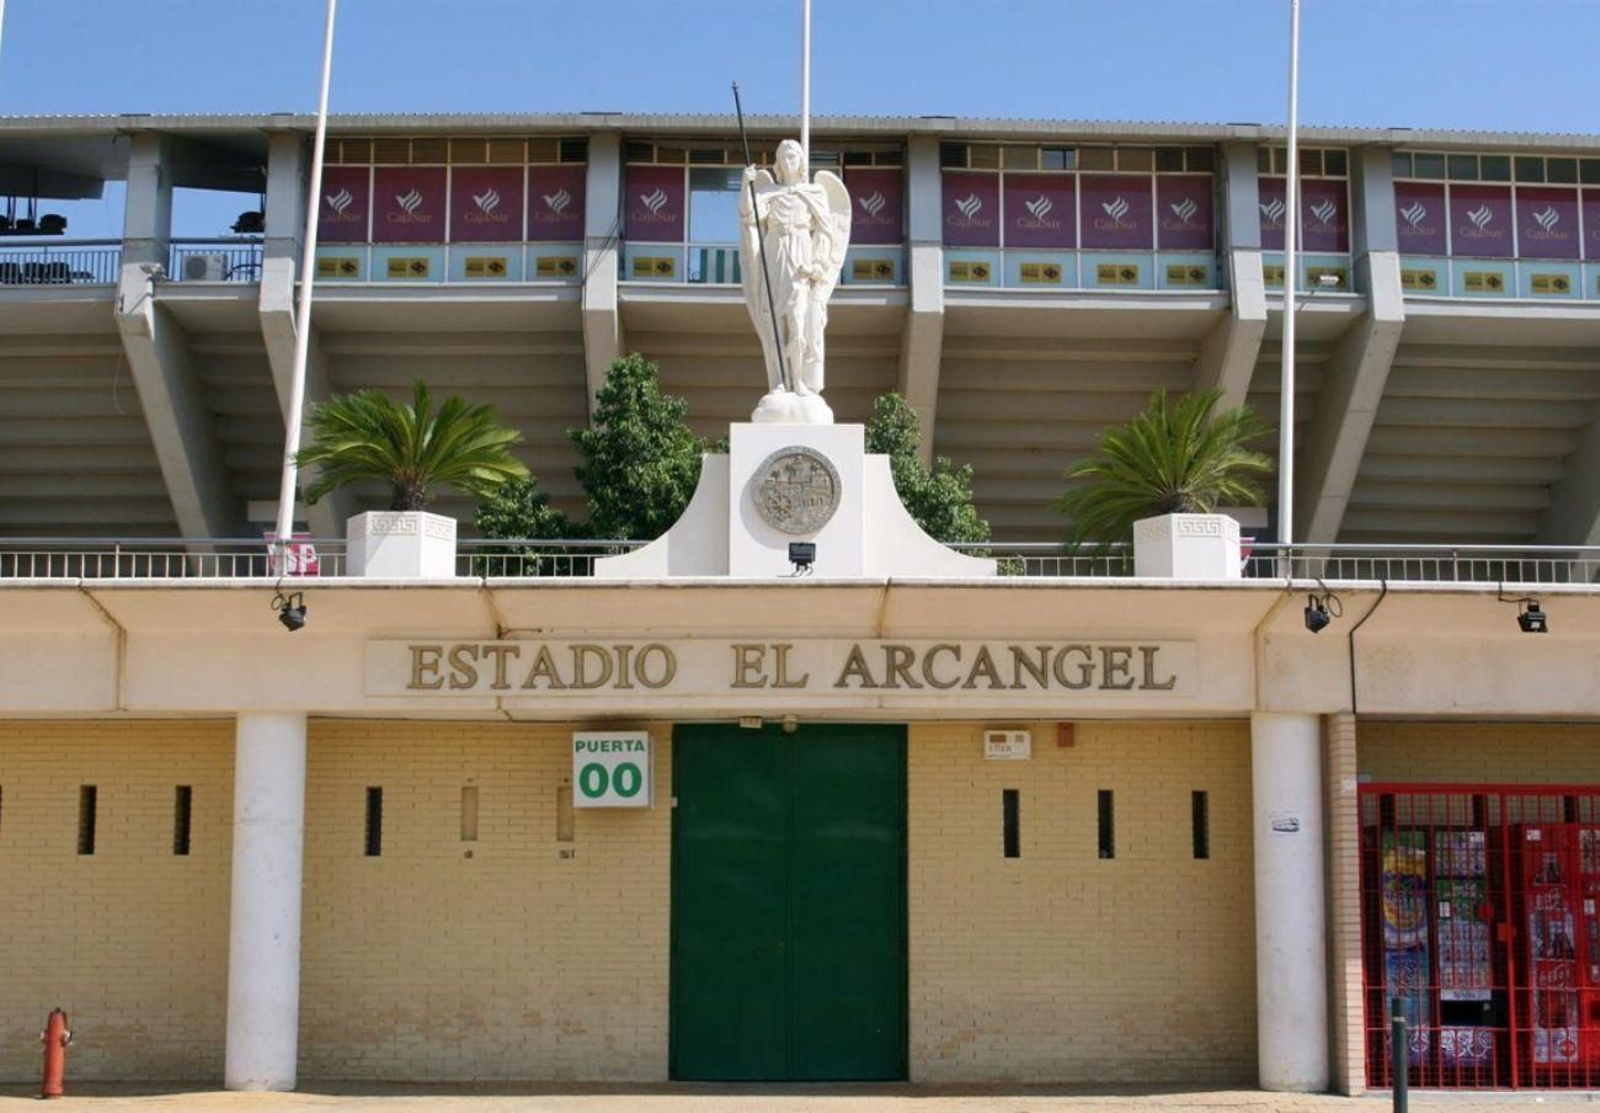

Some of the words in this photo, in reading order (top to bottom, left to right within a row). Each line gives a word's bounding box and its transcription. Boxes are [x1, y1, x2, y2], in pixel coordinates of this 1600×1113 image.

[406, 644, 677, 690] ESTADIO
[730, 644, 808, 689] EL
[833, 643, 1177, 690] ARCANGEL
[575, 740, 645, 752] PUERTA
[579, 762, 642, 798] 00
